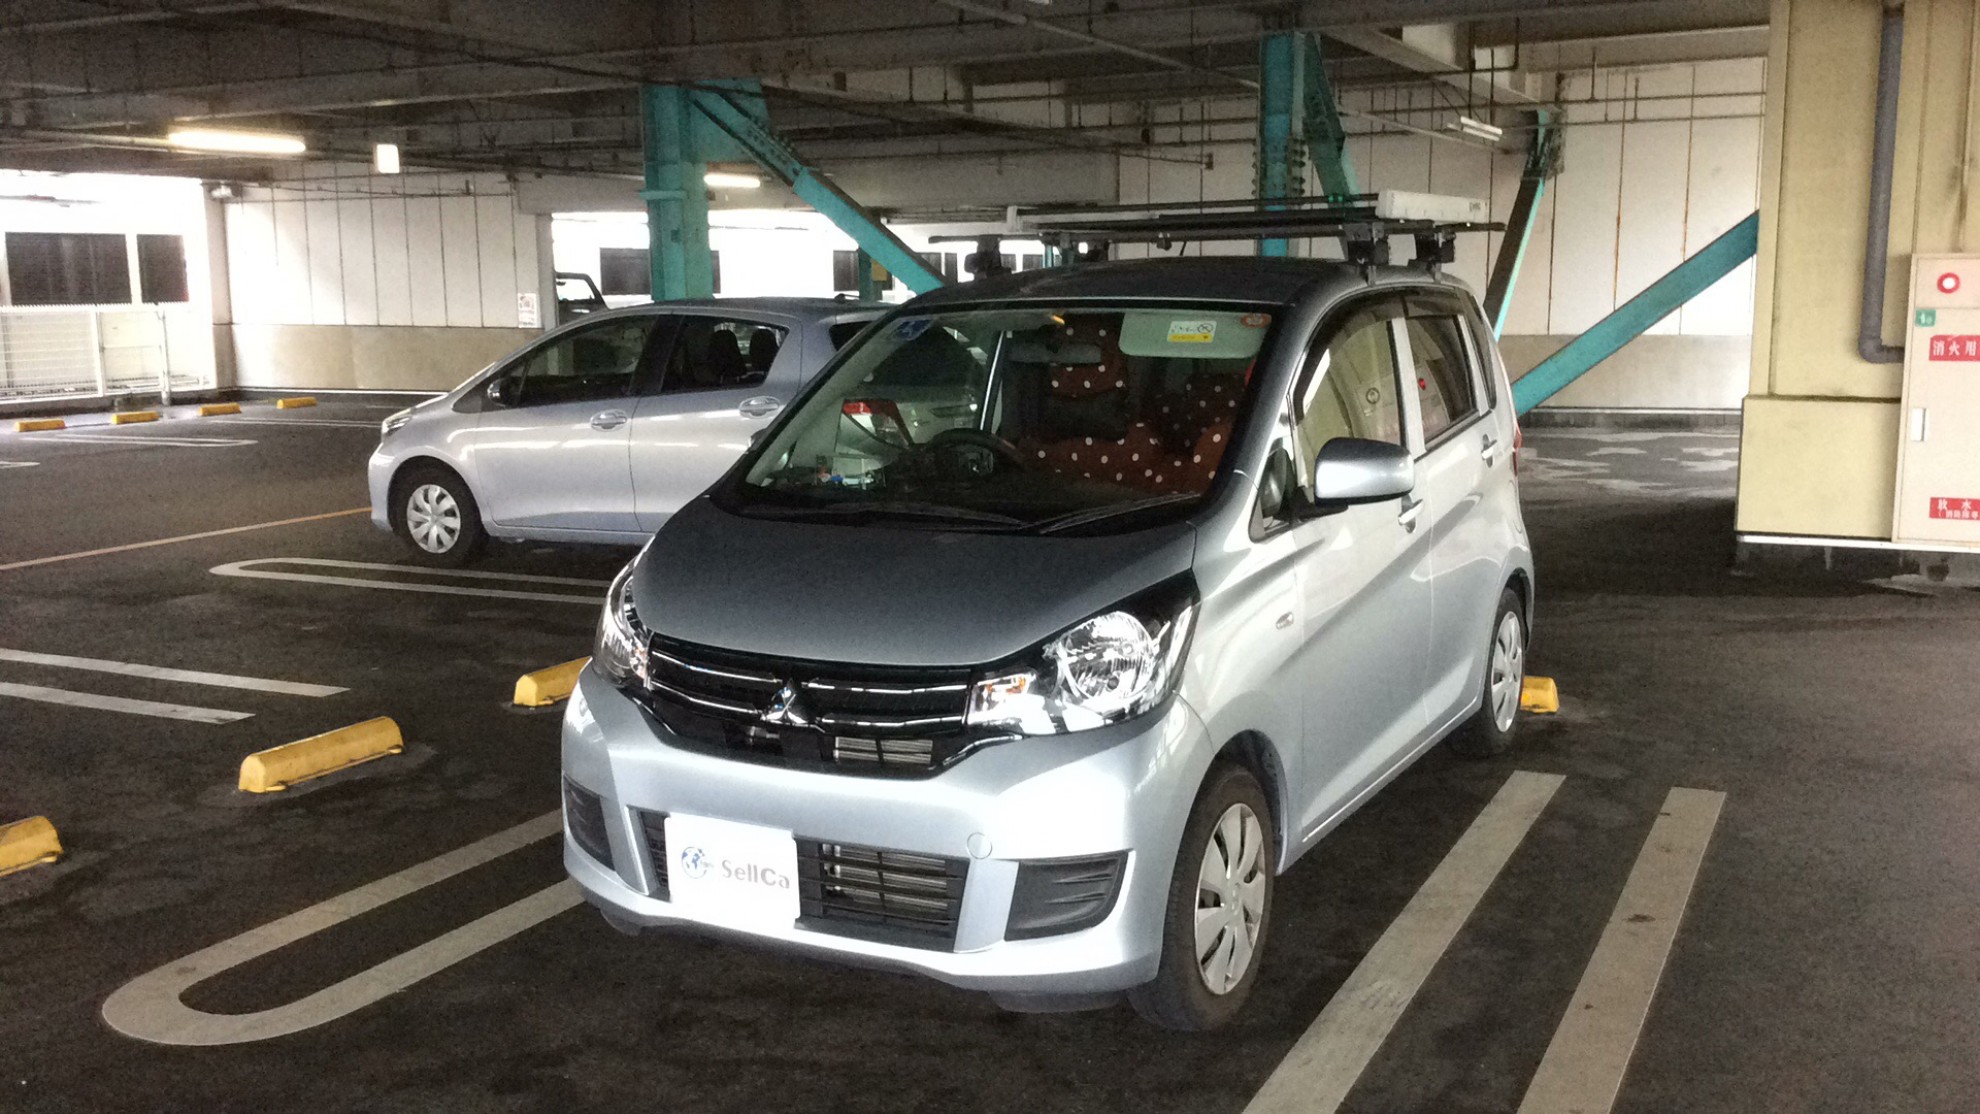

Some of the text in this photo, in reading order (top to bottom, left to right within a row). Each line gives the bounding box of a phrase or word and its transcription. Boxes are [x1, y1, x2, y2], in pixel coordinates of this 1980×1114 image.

[1932, 340, 1977, 357] 消火用
[721, 859, 790, 889] SellCa
